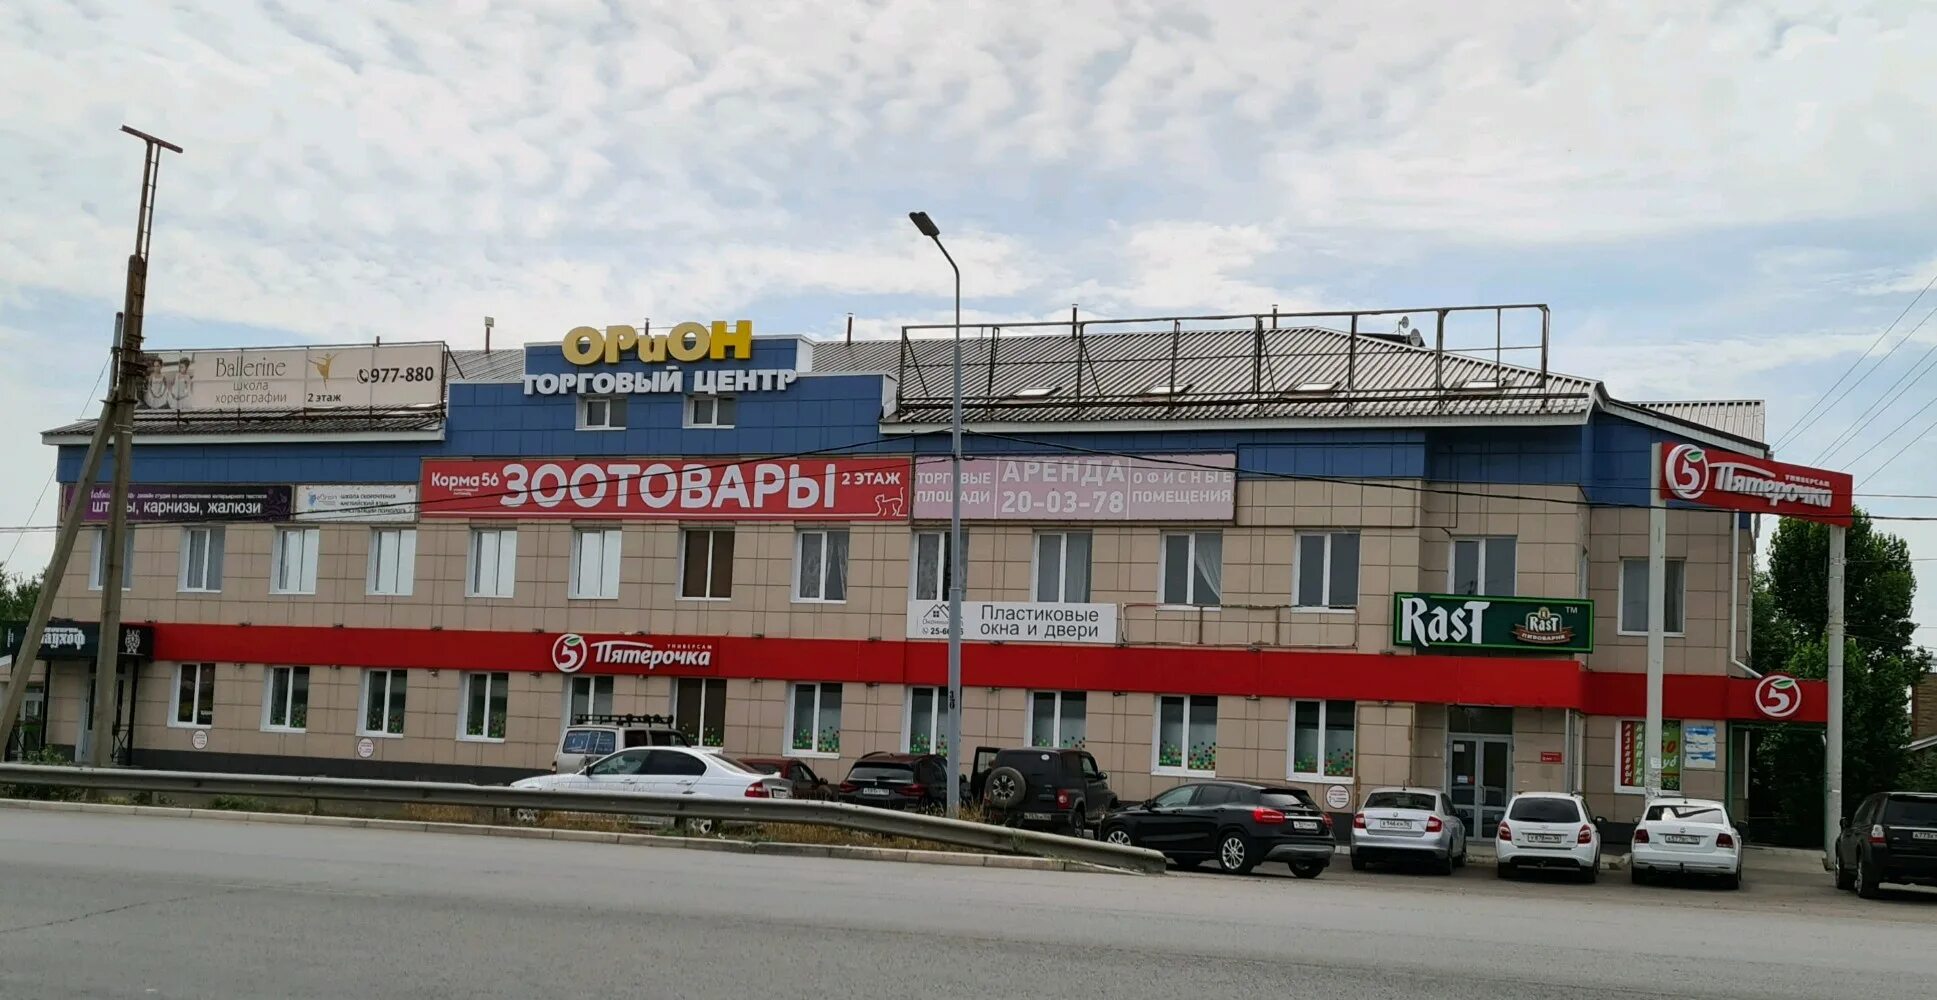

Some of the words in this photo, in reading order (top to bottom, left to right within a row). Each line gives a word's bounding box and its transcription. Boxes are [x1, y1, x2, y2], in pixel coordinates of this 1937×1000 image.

[215, 357, 286, 377] Ballerine
[370, 366, 434, 383] 977-880
[233, 380, 268, 391] школа
[523, 366, 682, 395] ТОРГОВЫЙ
[693, 369, 797, 395] ЦЕНТР
[215, 392, 287, 404] хореографии
[307, 393, 313, 402] 2
[316, 393, 341, 402] этаж
[917, 472, 991, 484] ТОРГВЫЕ
[1002, 460, 1125, 486] АРЕНДА
[1134, 472, 1232, 484] ОФИСНЫЕ
[432, 472, 479, 491] Корма
[482, 472, 499, 487] 56
[500, 463, 836, 508] ЗООТОВАРЫ
[842, 473, 850, 485] 2
[853, 472, 900, 486] ЭТАЖ
[1709, 462, 1832, 507] Пятерочка
[1002, 491, 1124, 513] 20-03-78
[1132, 490, 1232, 504] ПОМЕЩЕНИЯ
[92, 501, 139, 515] шты,
[143, 500, 203, 516] карнизы,
[207, 501, 261, 515] жалюзи
[981, 605, 1099, 623] Пластиковые
[981, 623, 1019, 636] окна
[1028, 625, 1037, 635] и
[1044, 624, 1098, 640] двери
[590, 640, 711, 669] Пятерочка
[1662, 755, 1678, 770] уб
